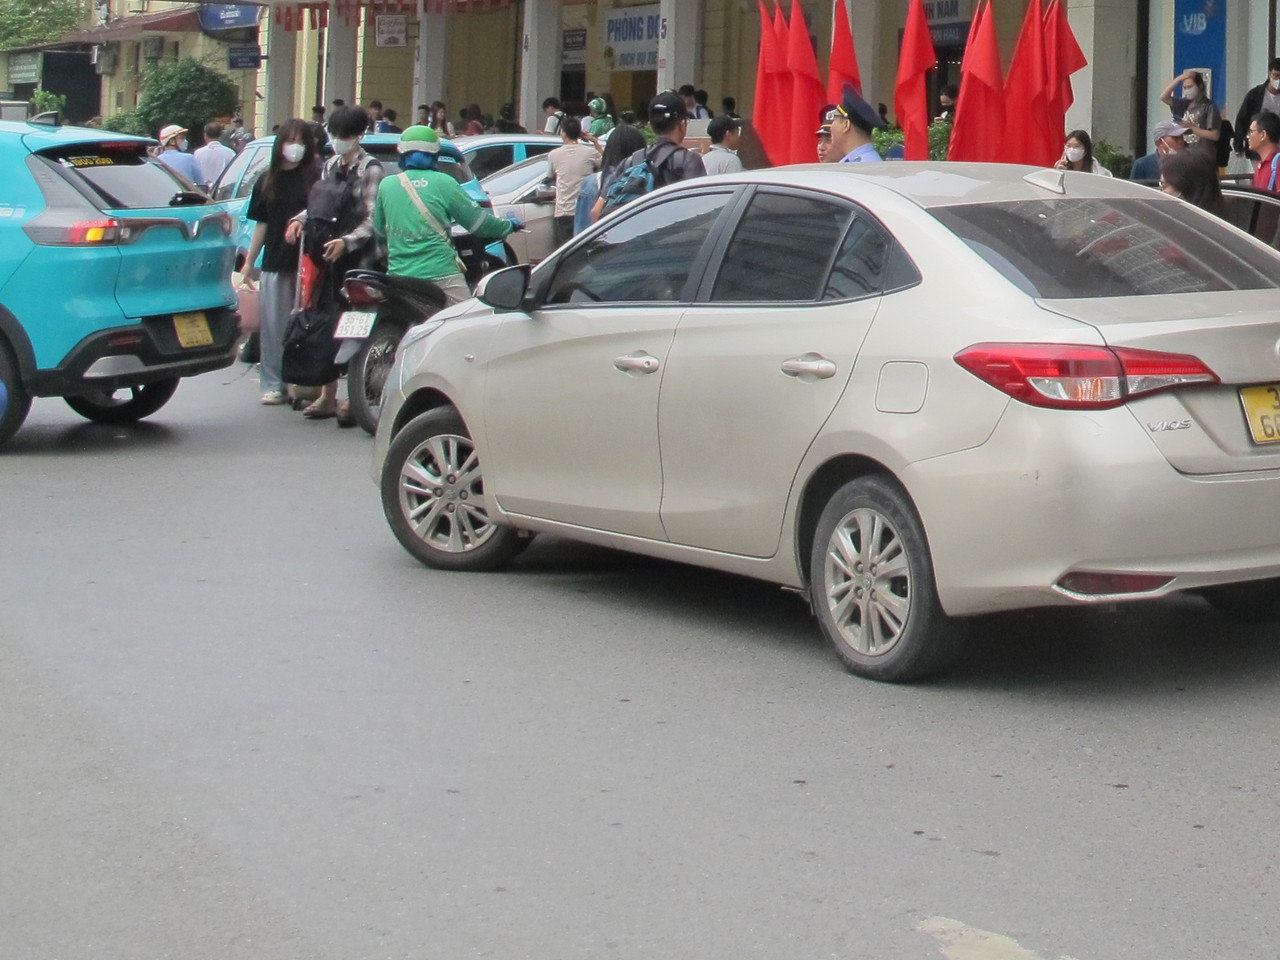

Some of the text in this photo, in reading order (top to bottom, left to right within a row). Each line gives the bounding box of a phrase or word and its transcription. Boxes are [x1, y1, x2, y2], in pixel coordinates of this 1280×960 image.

[937, 0, 959, 18] NAM
[660, 18, 667, 40] 5
[1182, 13, 1207, 32] VIB
[1146, 419, 1193, 433] VIOS
